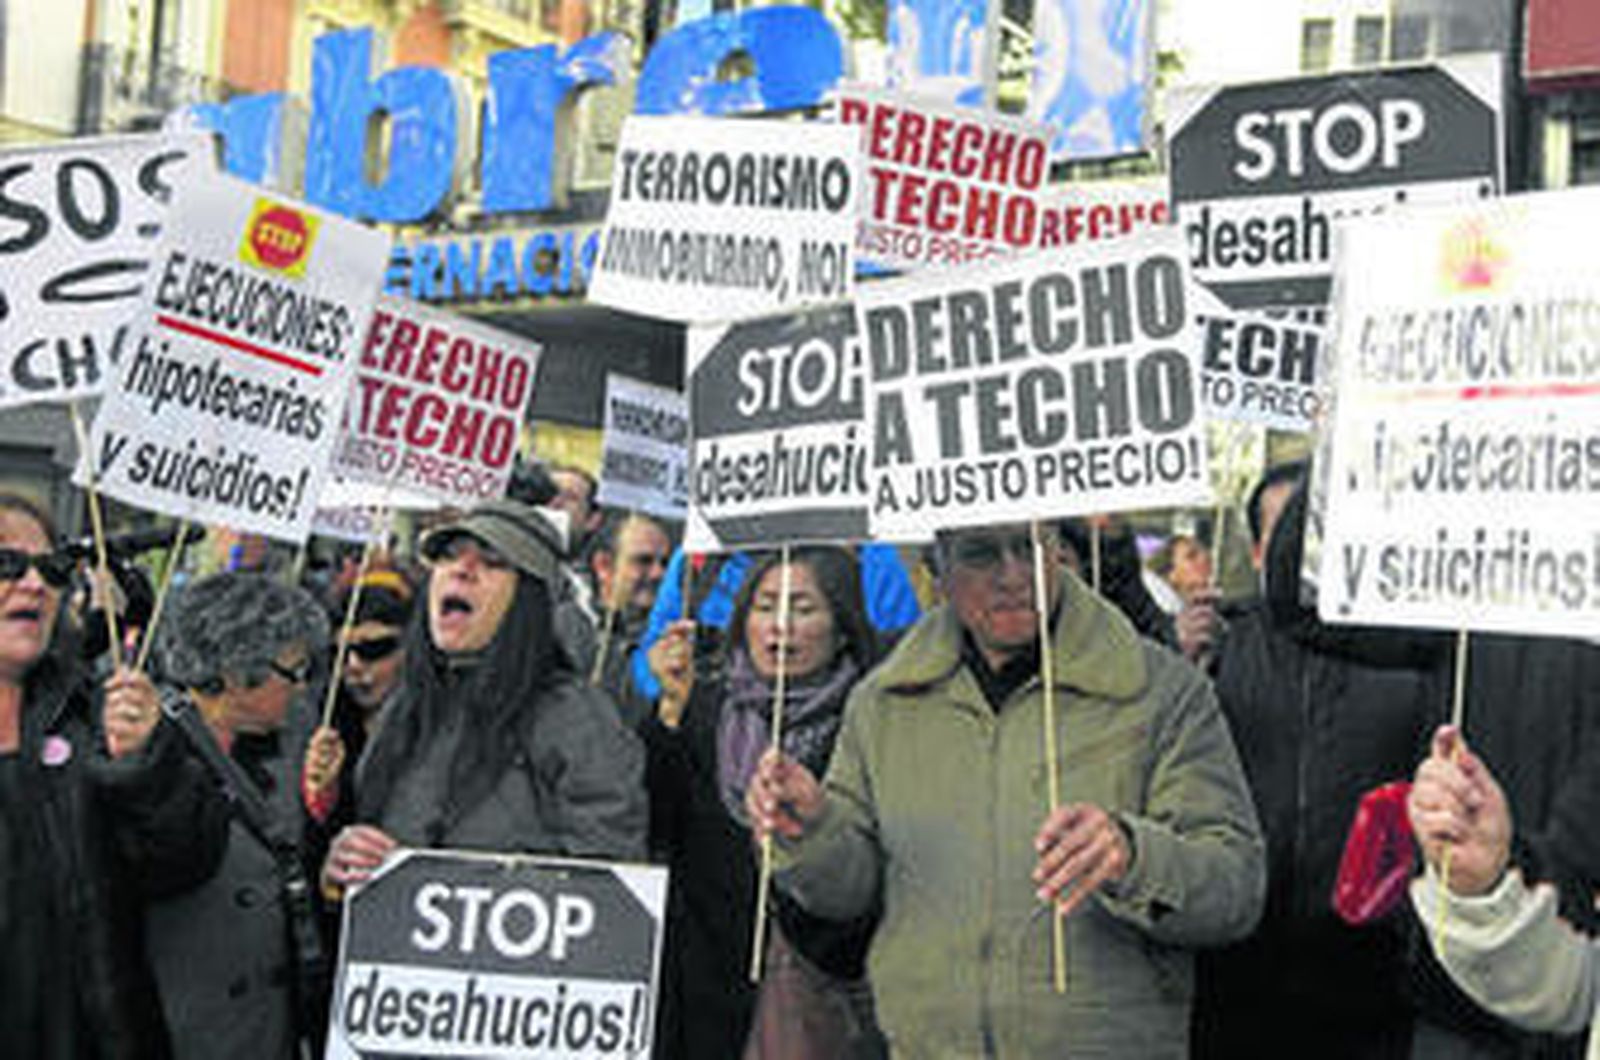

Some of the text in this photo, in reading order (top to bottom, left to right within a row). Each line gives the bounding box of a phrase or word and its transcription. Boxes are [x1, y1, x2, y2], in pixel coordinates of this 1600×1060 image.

[1234, 100, 1425, 181] STOP
[869, 167, 1036, 247] TECHO
[1187, 190, 1404, 268] desah
[797, 239, 847, 296] NO!
[865, 254, 1186, 383] DERECHO
[1197, 314, 1319, 386] ECH
[124, 336, 326, 442] hipotecarias
[358, 376, 517, 470] TECHO
[873, 348, 1195, 468] A TECHO
[128, 438, 310, 521] suicidios!
[874, 437, 1200, 514] A JUSTO PRECIO!
[1346, 415, 1600, 511] ipotecarias
[411, 882, 596, 961] STOP
[346, 968, 645, 1052] desahucios!
